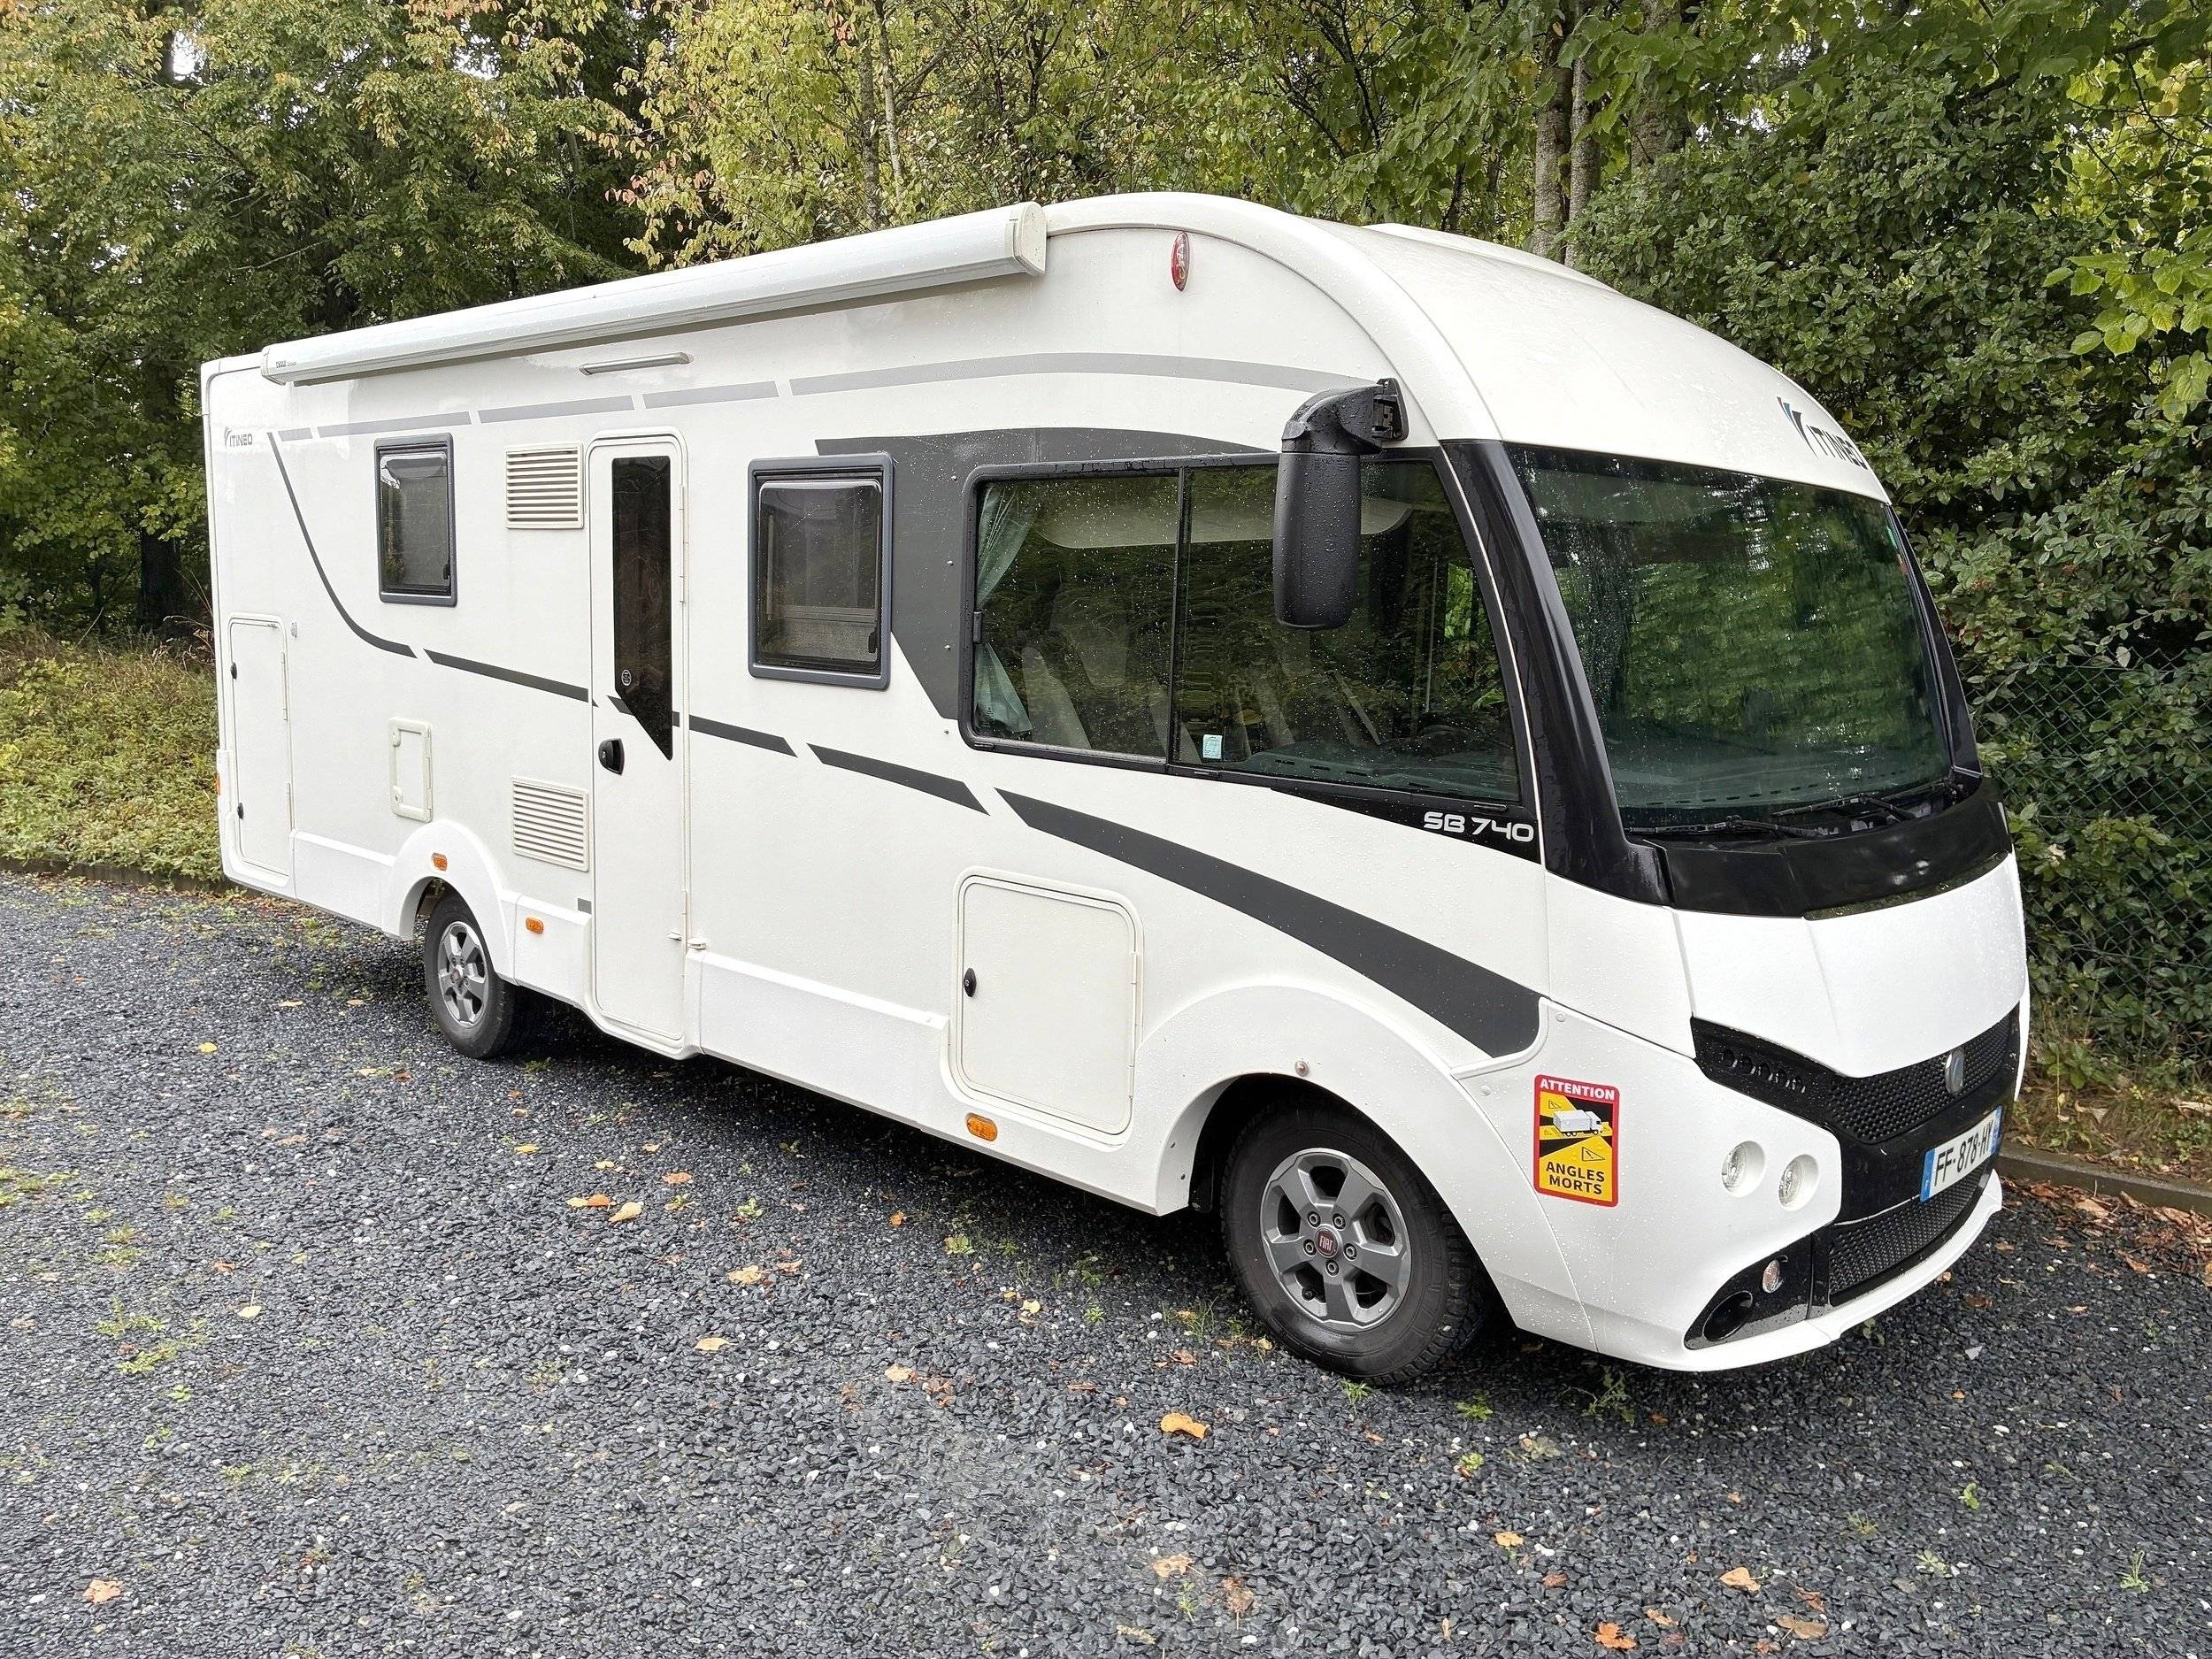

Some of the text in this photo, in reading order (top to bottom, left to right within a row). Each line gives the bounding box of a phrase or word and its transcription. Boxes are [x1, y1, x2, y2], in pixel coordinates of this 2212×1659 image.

[1806, 425, 1868, 470] ITINEO
[1424, 811, 1534, 842] SB 740
[1540, 1079, 1615, 1101] ATTENTION
[1546, 1162, 1605, 1182] ANGLES
[1549, 1175, 1602, 1195] MORTS
[1319, 1236, 1333, 1251] FIAT
